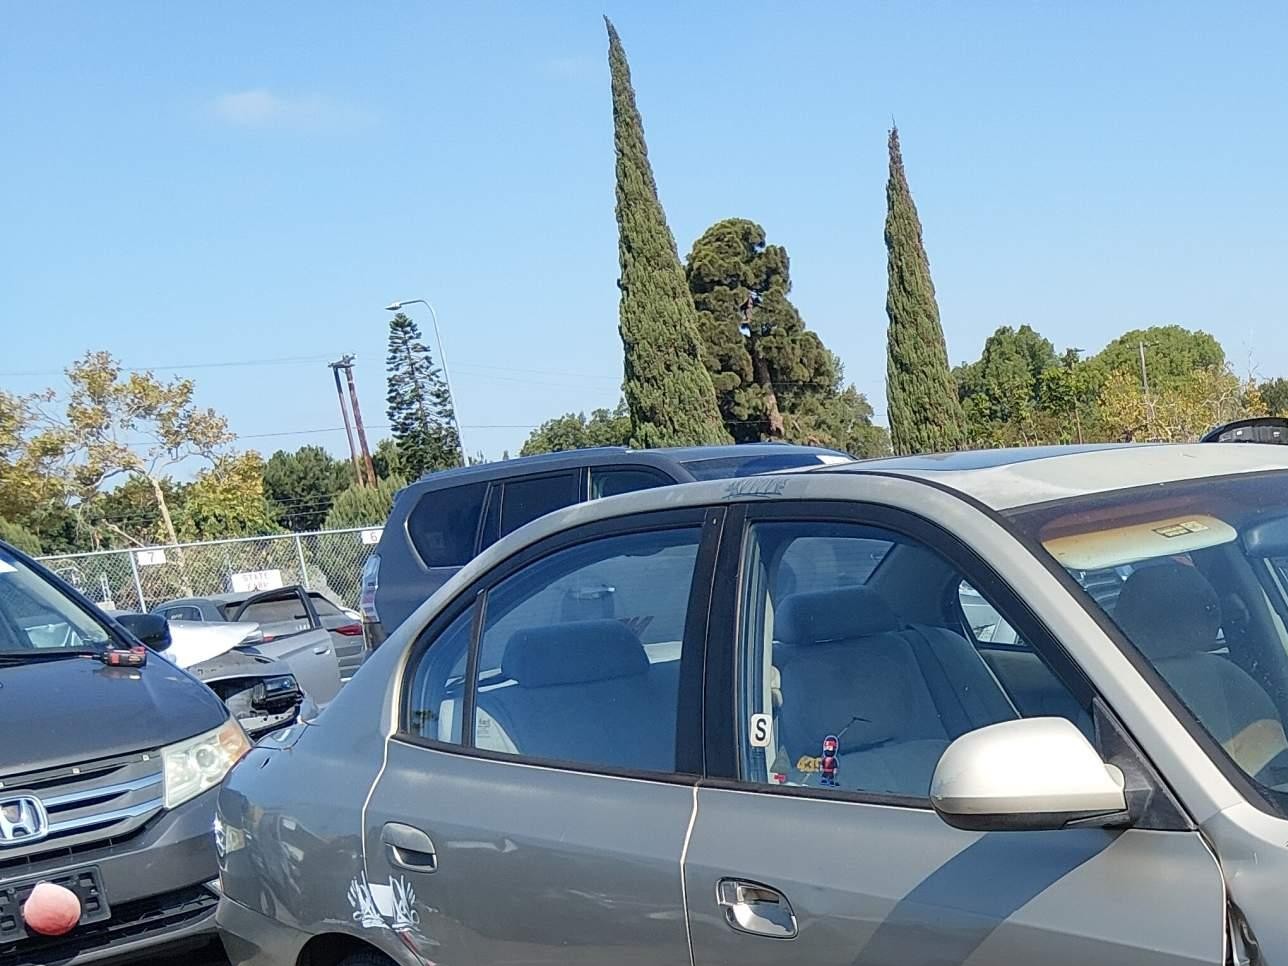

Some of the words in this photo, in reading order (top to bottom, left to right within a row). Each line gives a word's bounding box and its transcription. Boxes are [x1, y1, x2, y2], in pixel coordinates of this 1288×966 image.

[370, 532, 378, 542] 6
[147, 551, 154, 563] 7
[755, 718, 767, 741] S
